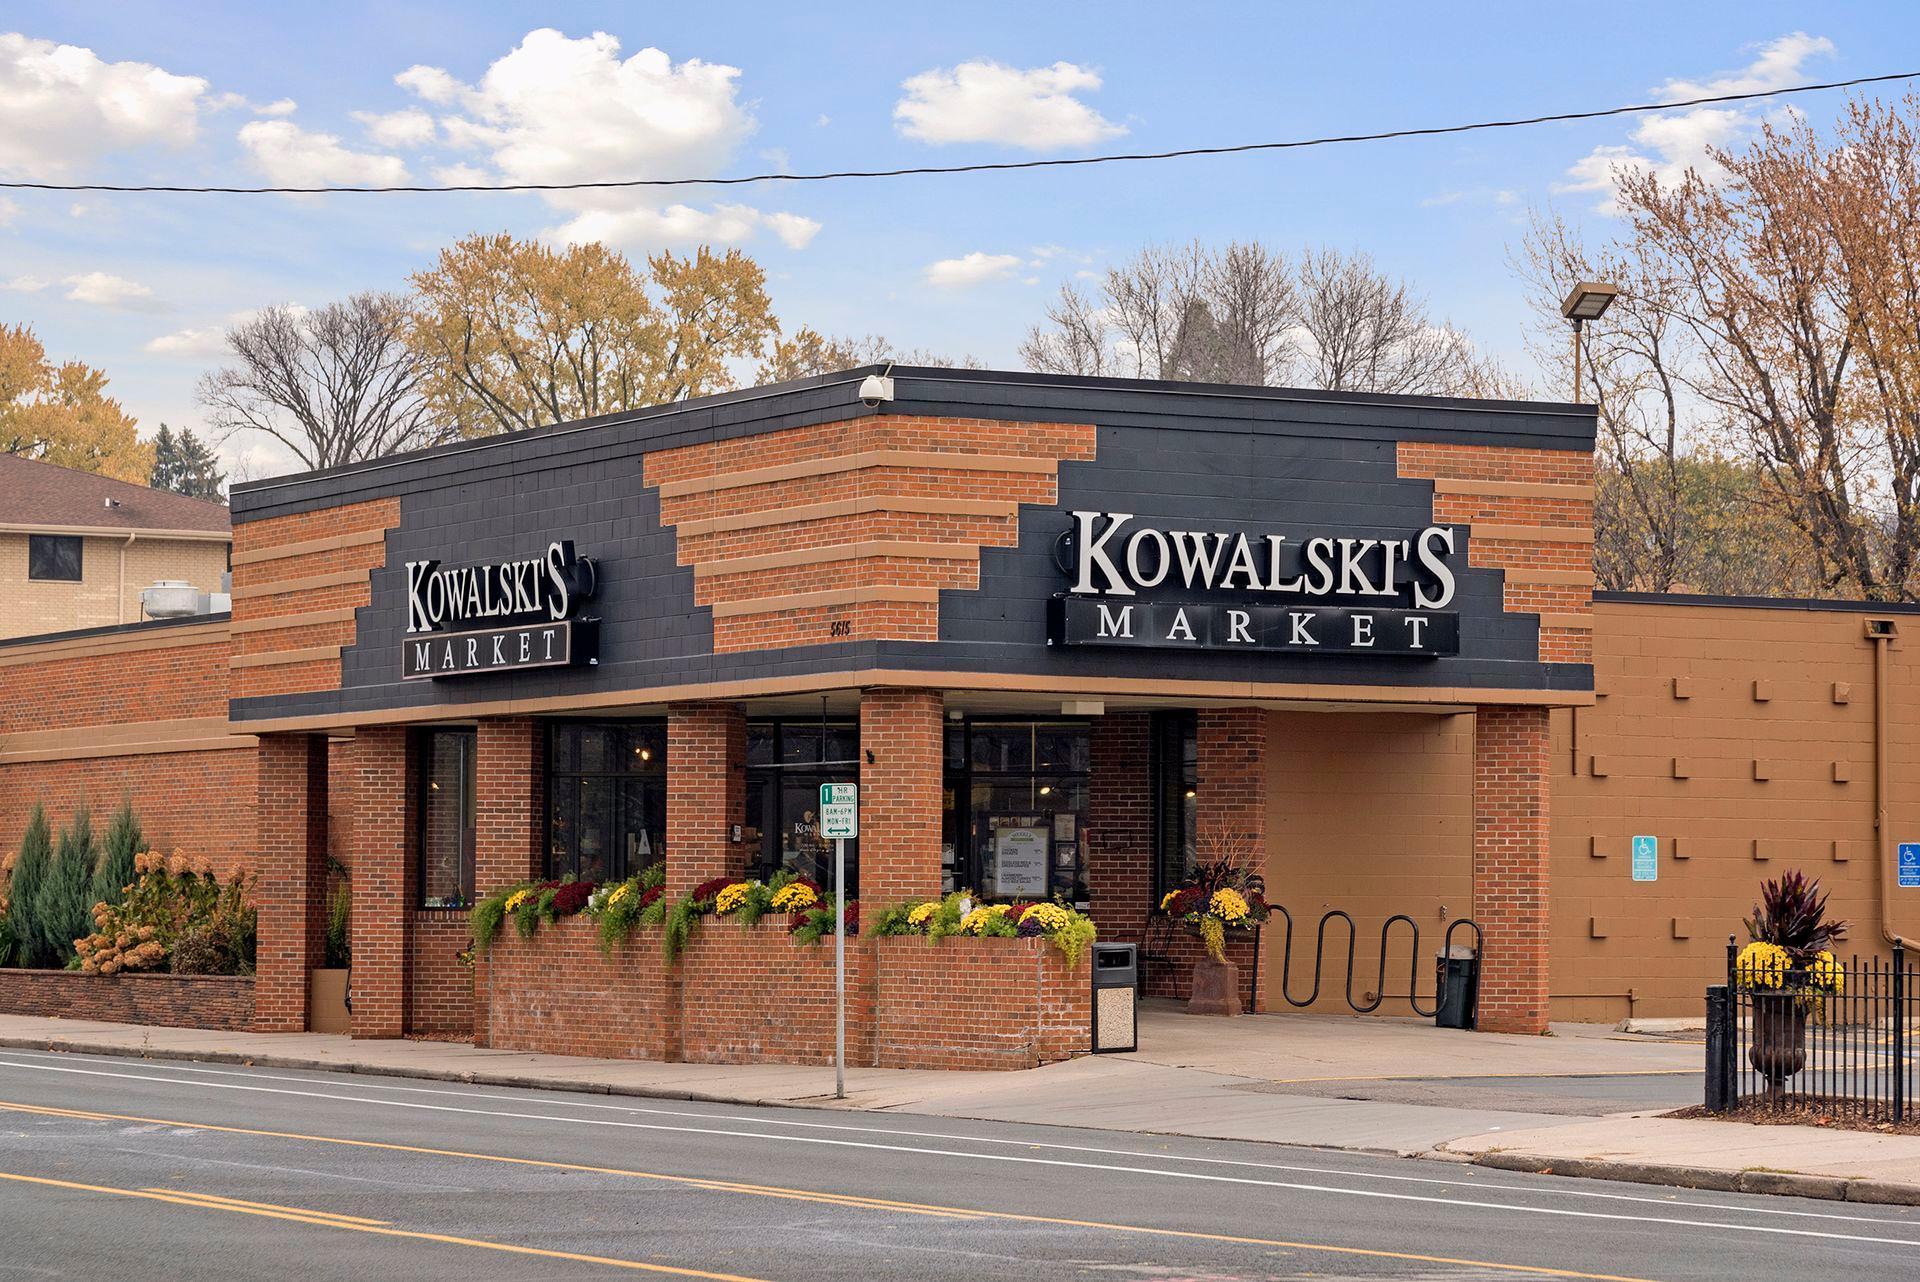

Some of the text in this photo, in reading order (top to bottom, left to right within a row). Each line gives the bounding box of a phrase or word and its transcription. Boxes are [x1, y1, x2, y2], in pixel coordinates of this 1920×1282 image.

[1069, 510, 1456, 609] KOWALSKI'S
[405, 542, 568, 632] KOWALSKI'S
[830, 620, 850, 637] 5615
[1096, 605, 1429, 649] MARKET
[415, 630, 554, 671] MARKET
[825, 786, 848, 802] 1 HR
[825, 807, 852, 816] 8AM-6PM
[827, 817, 851, 825] MON-FRI
